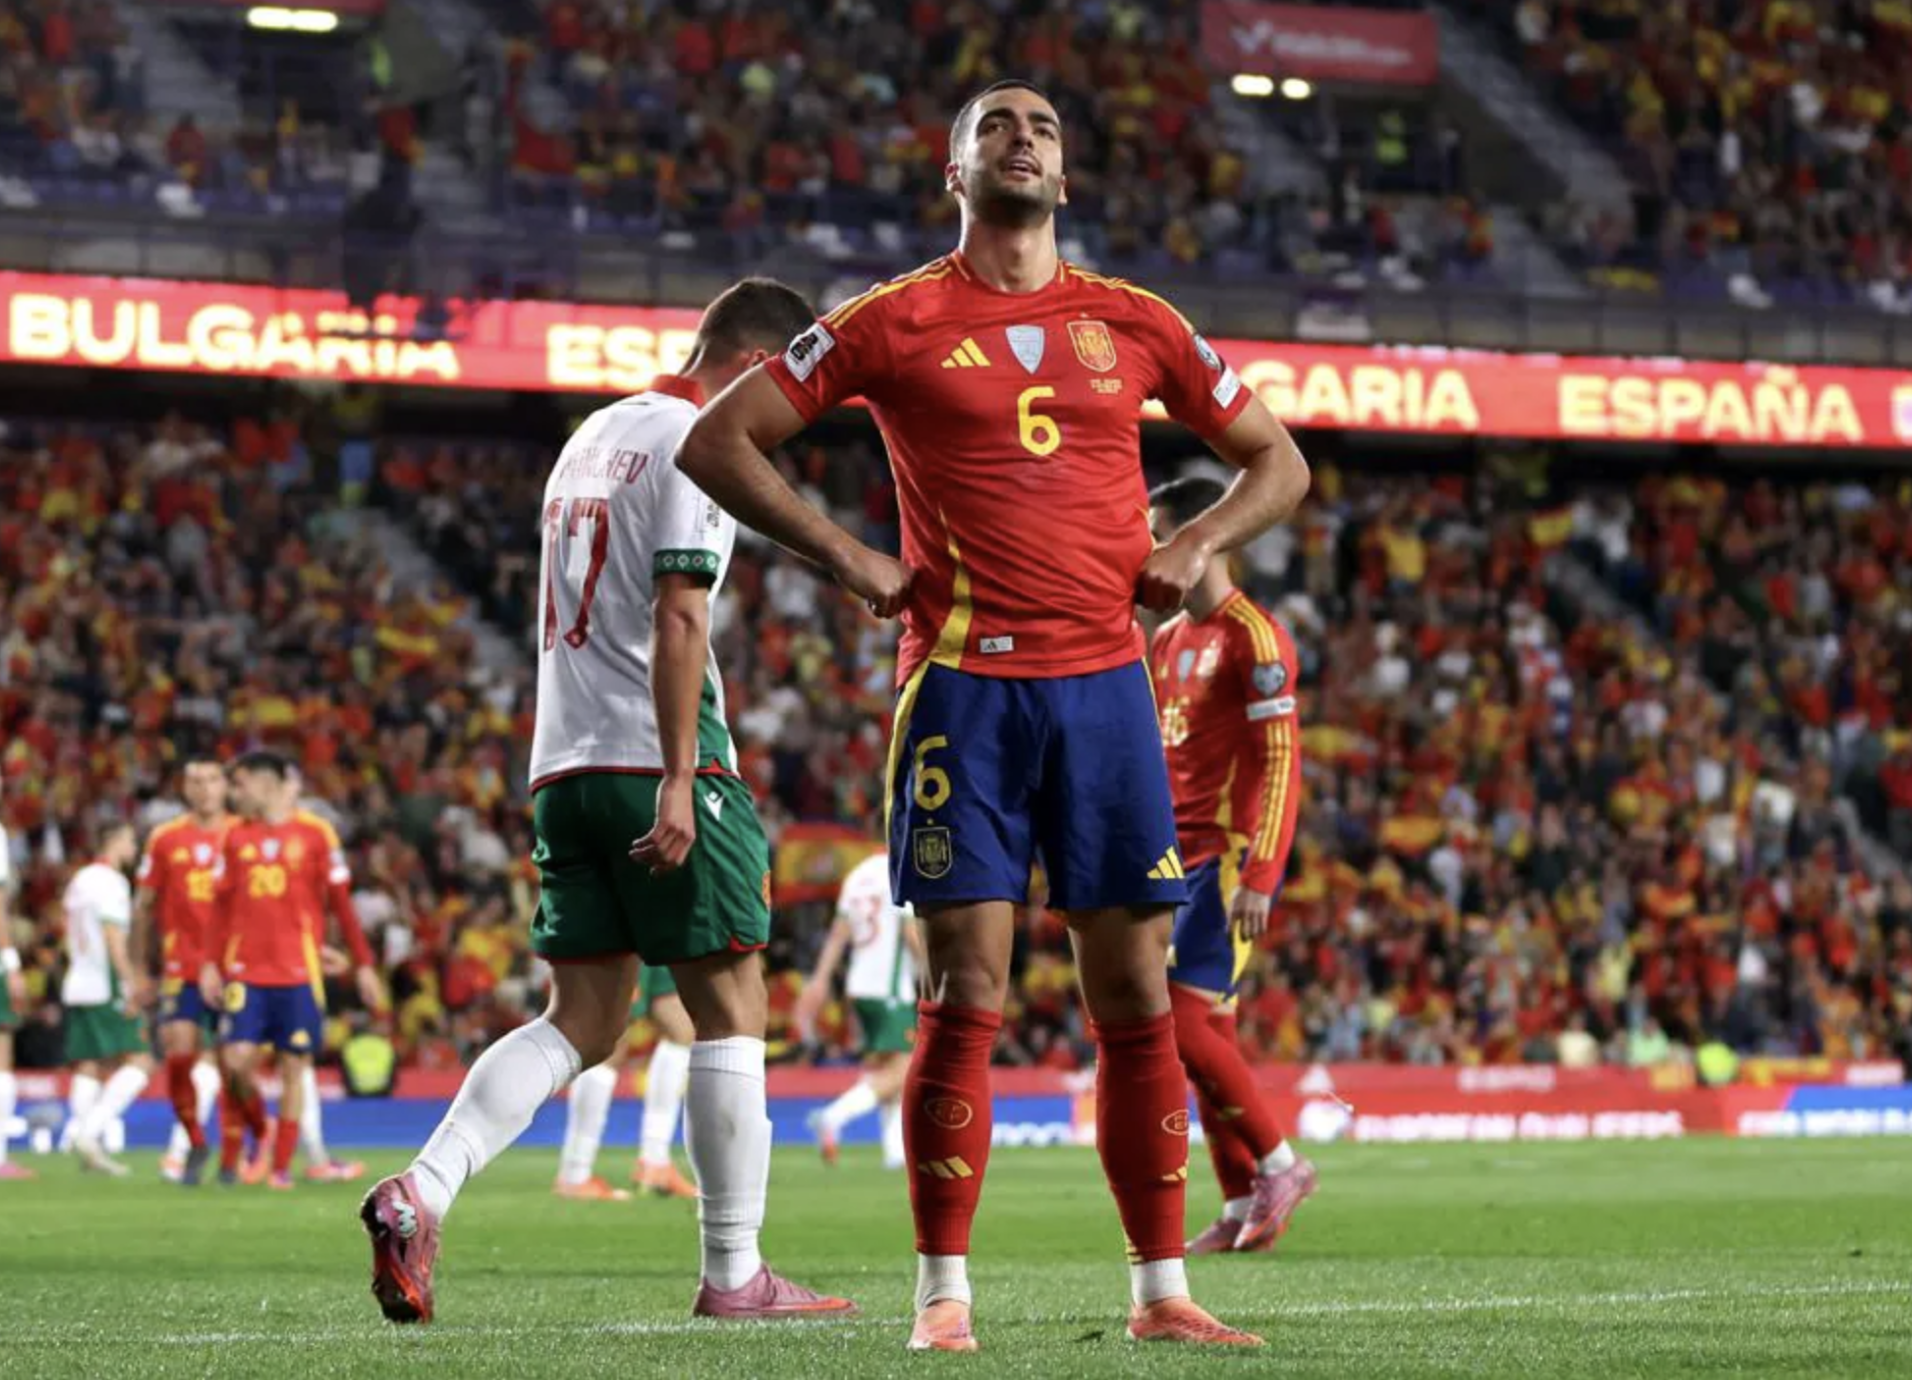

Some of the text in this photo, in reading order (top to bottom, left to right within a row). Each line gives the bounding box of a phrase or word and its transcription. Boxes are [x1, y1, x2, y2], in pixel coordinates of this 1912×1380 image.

[9, 293, 460, 379] BULGARIA
[546, 323, 695, 391] ESP
[1017, 386, 1061, 456] 6
[1240, 360, 1479, 429] GARIA
[1557, 366, 1863, 442] ESPAÑA
[543, 497, 609, 652] 17
[913, 734, 951, 811] 6
[248, 863, 287, 899] 20
